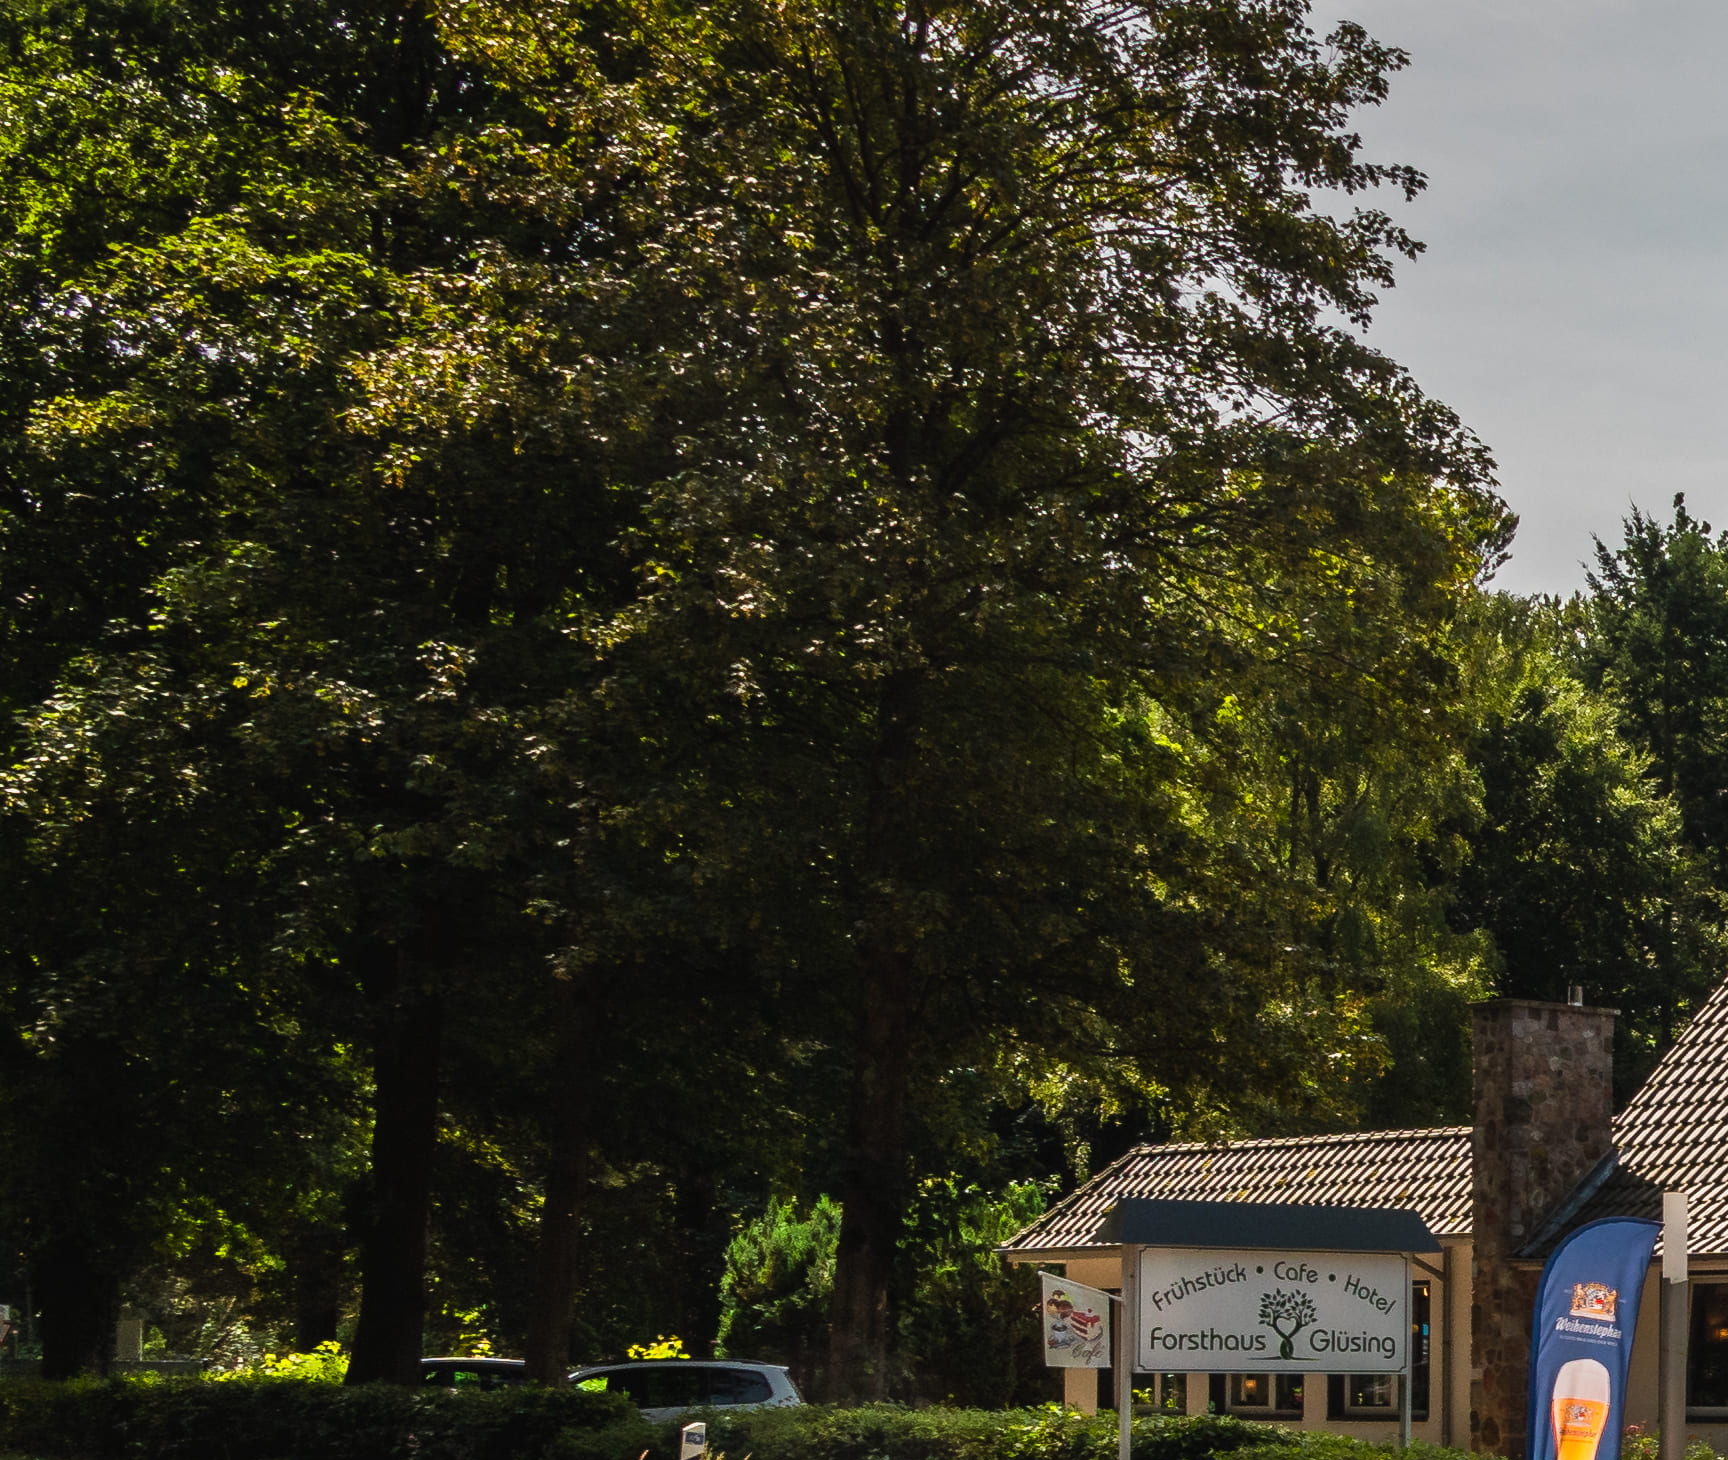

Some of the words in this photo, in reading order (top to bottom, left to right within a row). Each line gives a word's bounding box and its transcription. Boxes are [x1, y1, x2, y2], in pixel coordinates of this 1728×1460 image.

[1152, 1262, 1247, 1311] Frühstück
[1274, 1261, 1319, 1283] Cafe
[1344, 1275, 1396, 1315] Hotel
[1150, 1327, 1266, 1351] Forsthaus
[1309, 1329, 1396, 1359] Glüsing
